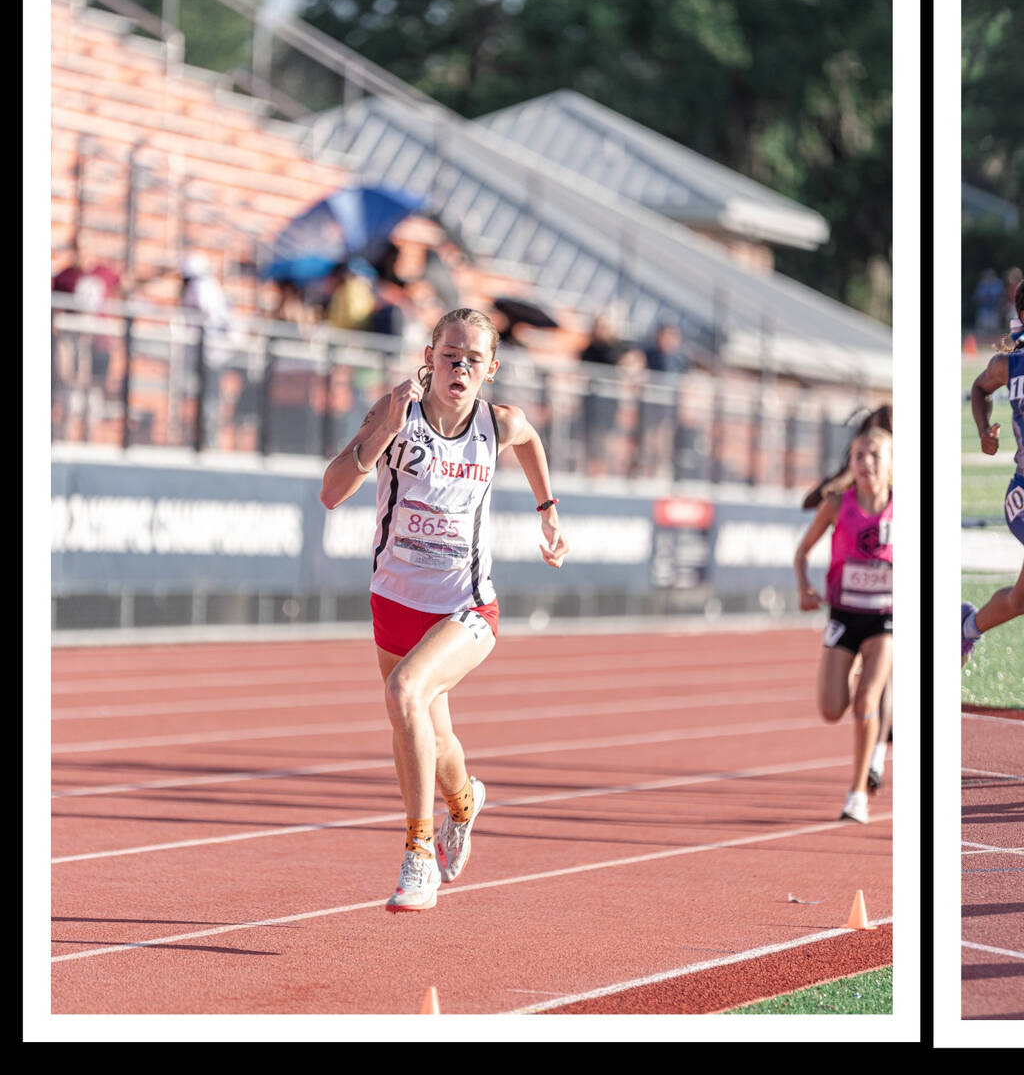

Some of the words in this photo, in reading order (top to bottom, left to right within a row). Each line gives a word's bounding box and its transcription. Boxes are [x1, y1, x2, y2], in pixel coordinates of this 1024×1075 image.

[395, 440, 427, 477] 12
[440, 460, 491, 483] SEATTLE
[1006, 489, 1024, 517] 10
[407, 514, 461, 538] 8655
